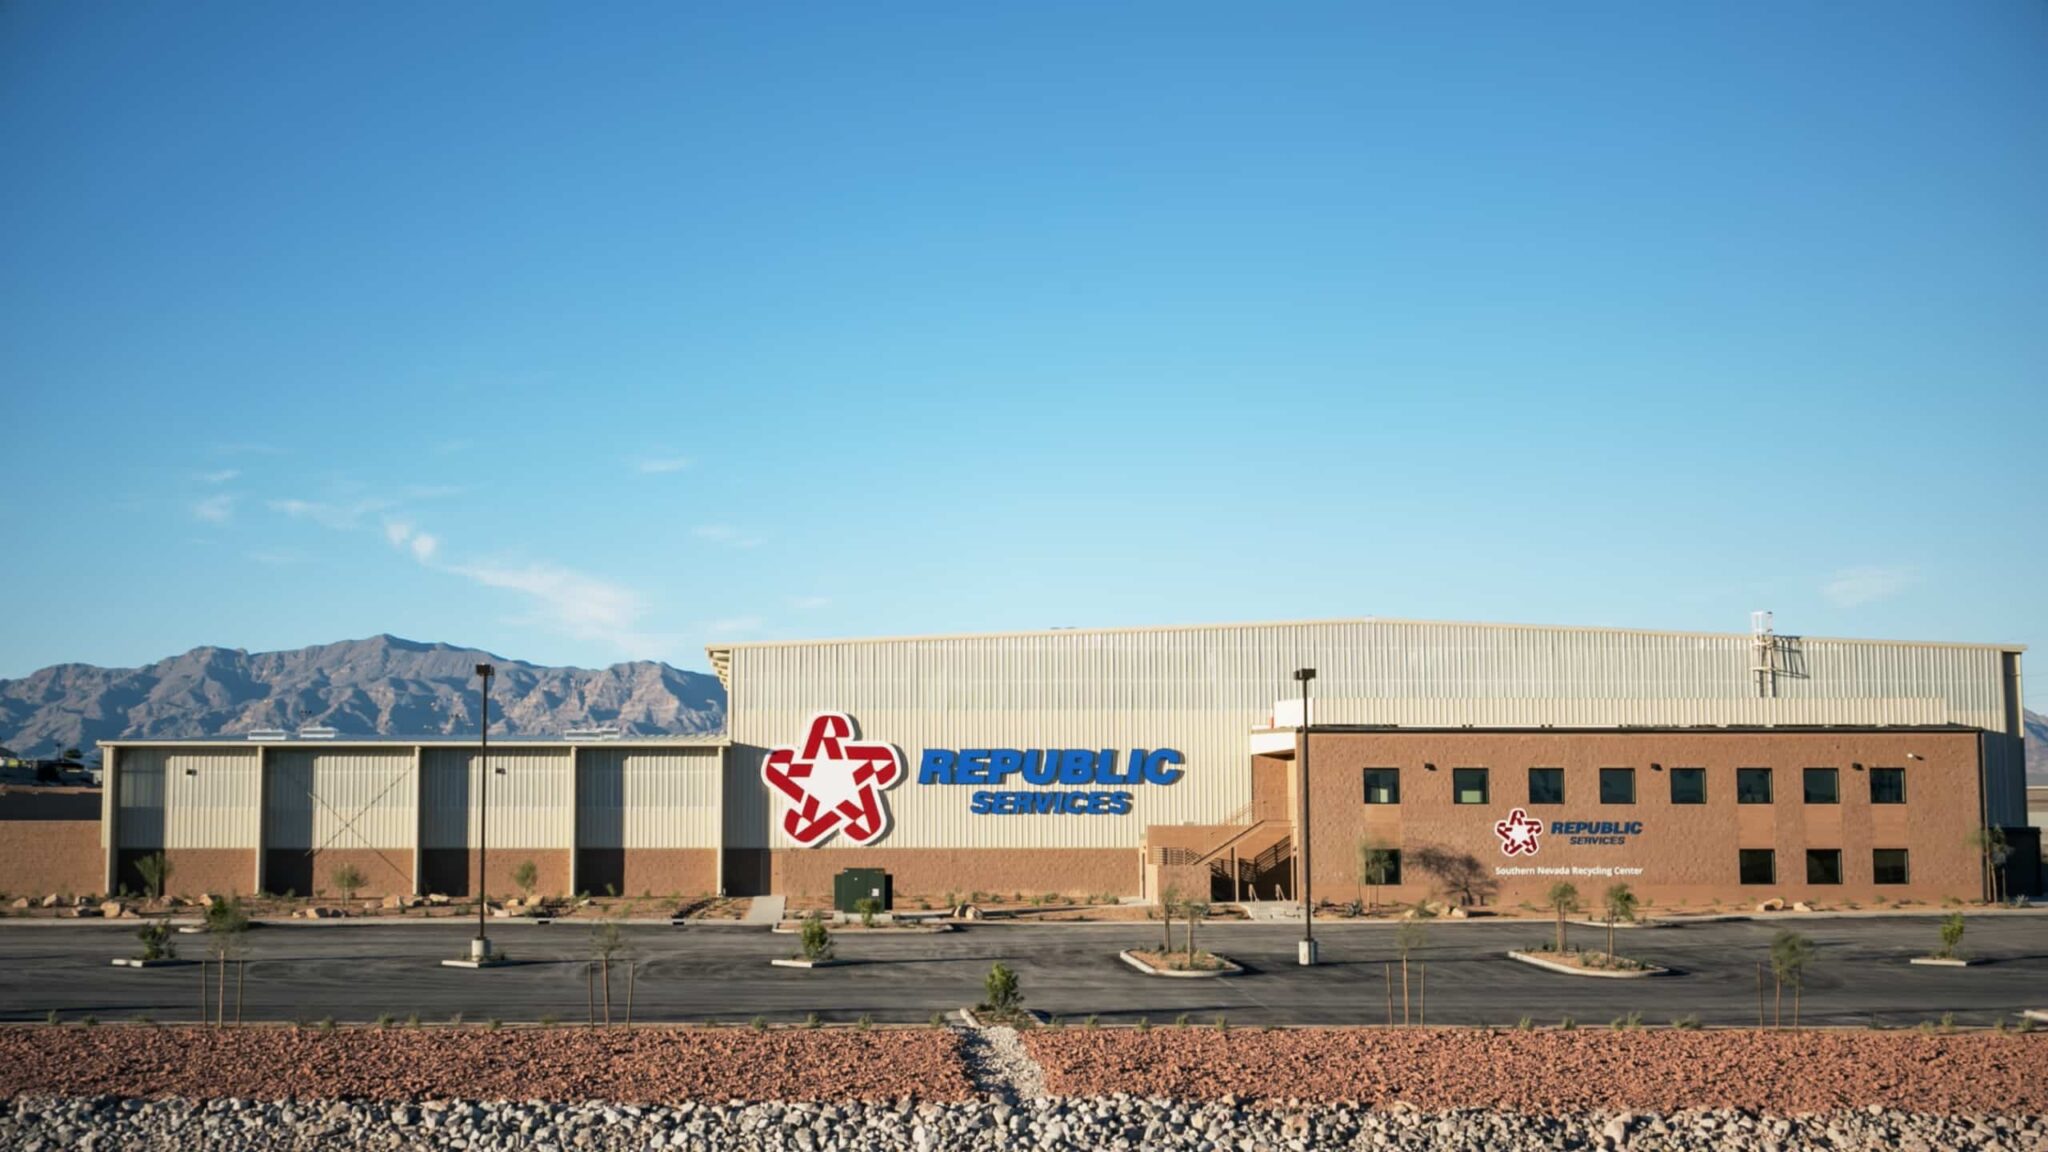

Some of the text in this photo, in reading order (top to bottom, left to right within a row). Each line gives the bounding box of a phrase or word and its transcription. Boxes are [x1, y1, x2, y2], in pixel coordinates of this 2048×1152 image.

[918, 748, 1183, 785] REPUBLIC
[970, 790, 1132, 815] SERVICES
[1551, 821, 1643, 835] REPUBLIC
[1569, 836, 1625, 845] SERVICES
[1495, 866, 1643, 877] Southern Nevada Recycling Center
